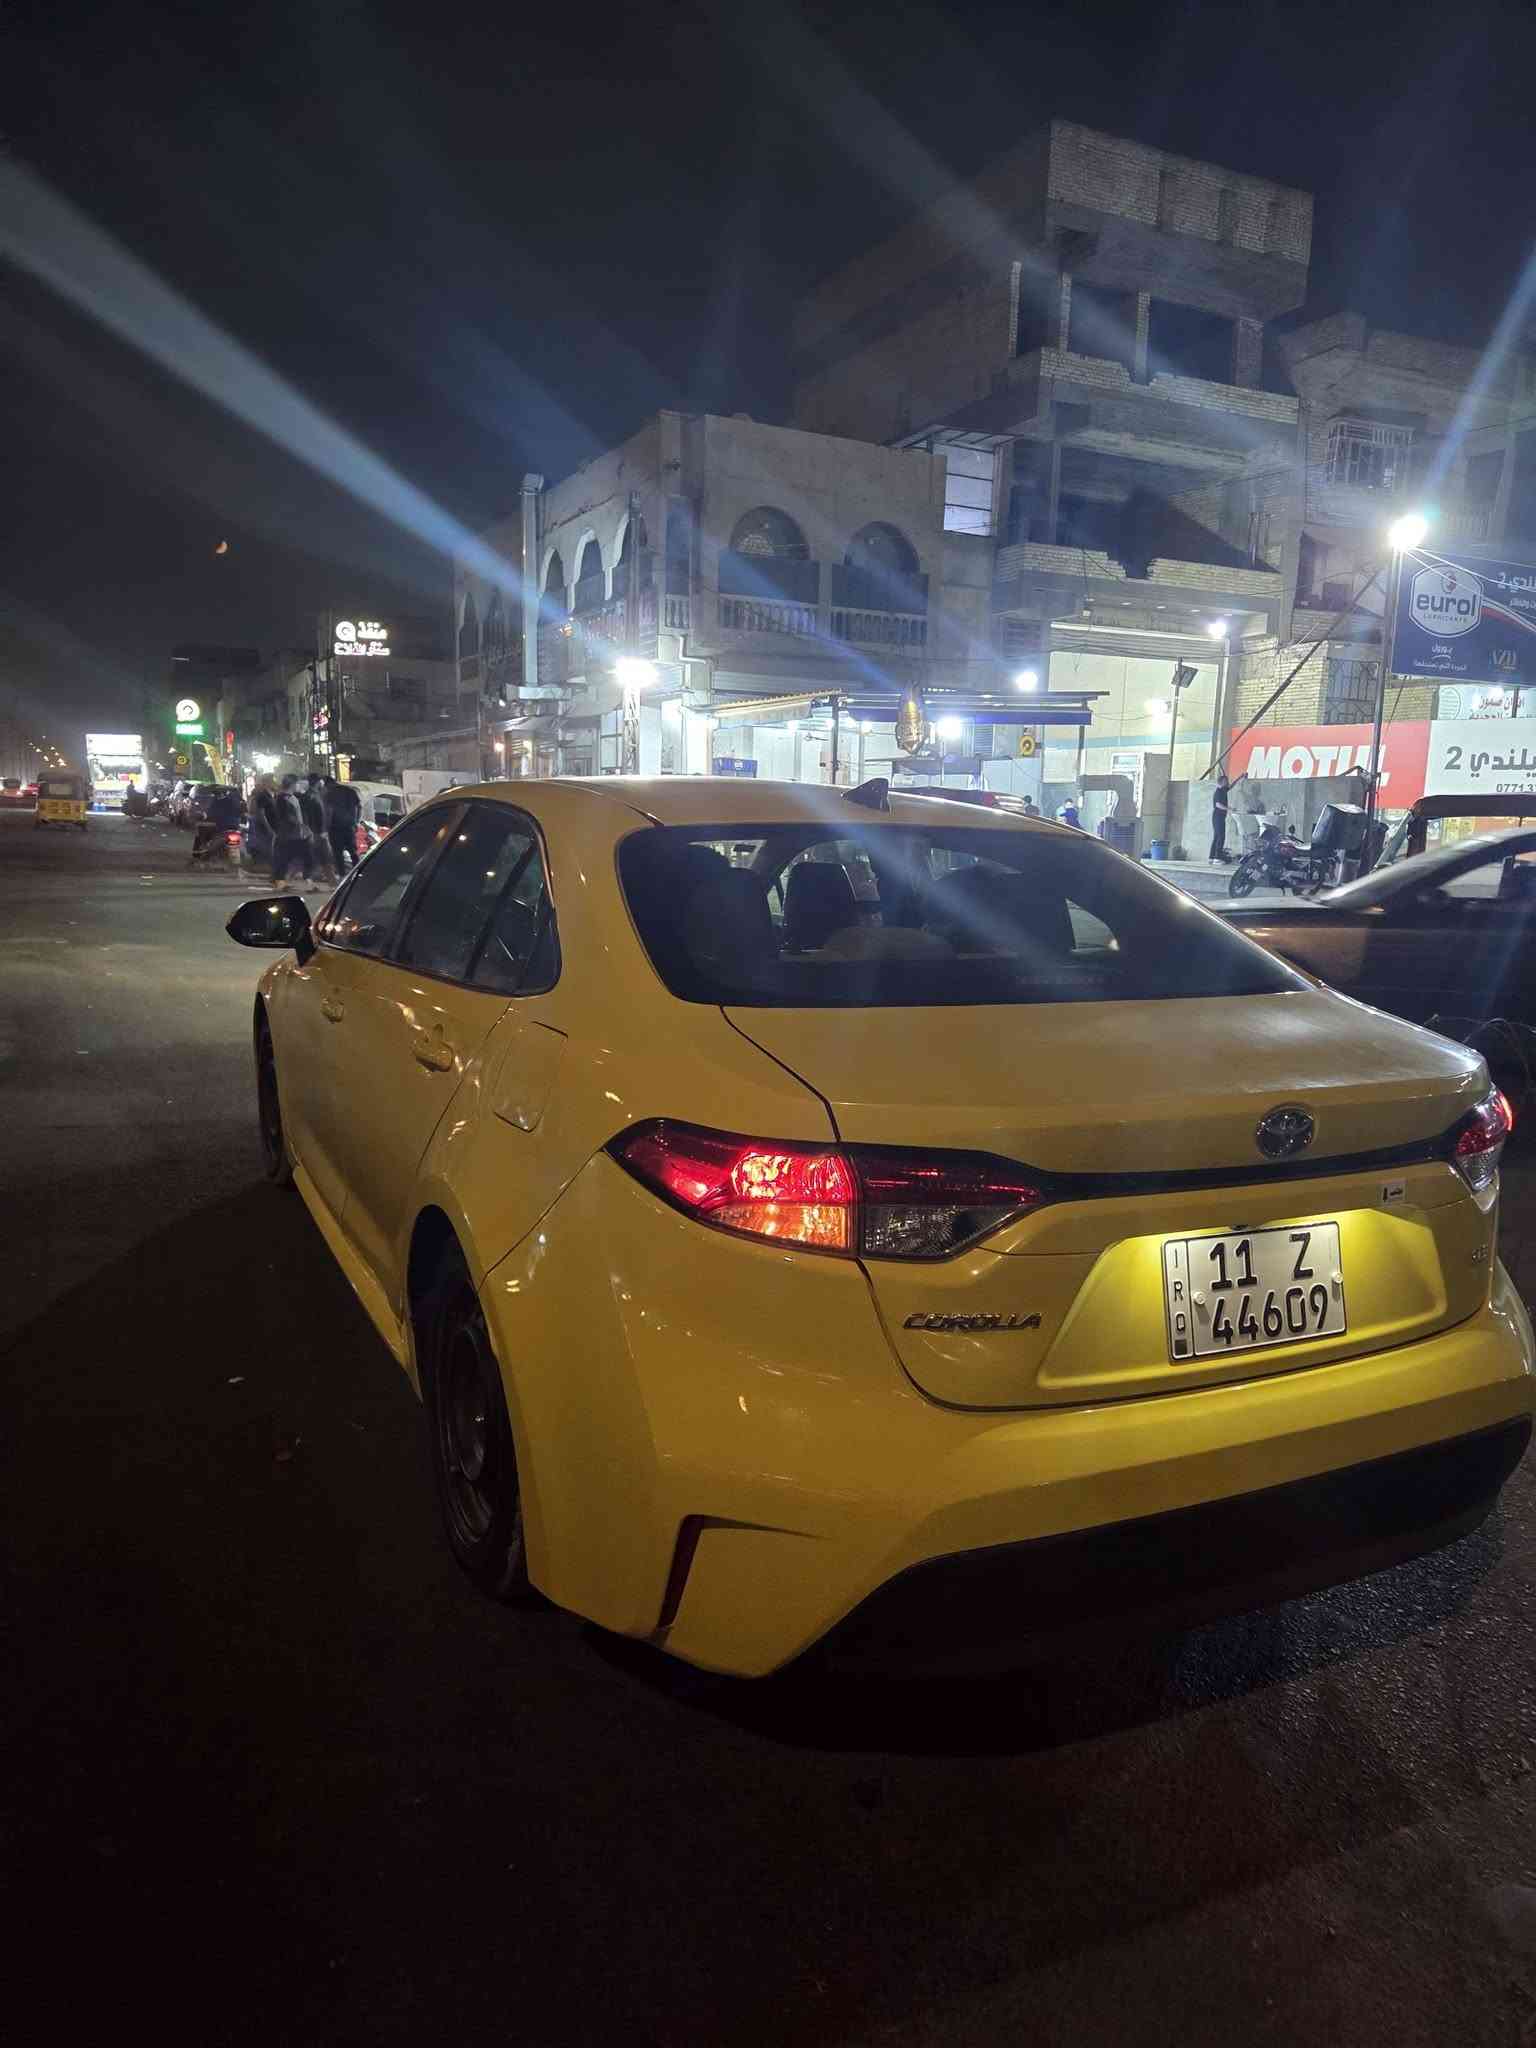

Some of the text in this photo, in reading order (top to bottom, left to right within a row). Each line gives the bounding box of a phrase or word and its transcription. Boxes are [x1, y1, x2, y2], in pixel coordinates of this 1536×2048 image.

[1416, 593, 1478, 617] eurol
[1247, 746, 1391, 787] MOTUL
[1444, 745, 1463, 770] 2
[1496, 783, 1536, 793] 07713
[1209, 1232, 1314, 1291] 11 Z
[903, 1312, 1042, 1332] COROLLA
[1212, 1285, 1329, 1345] 44609
